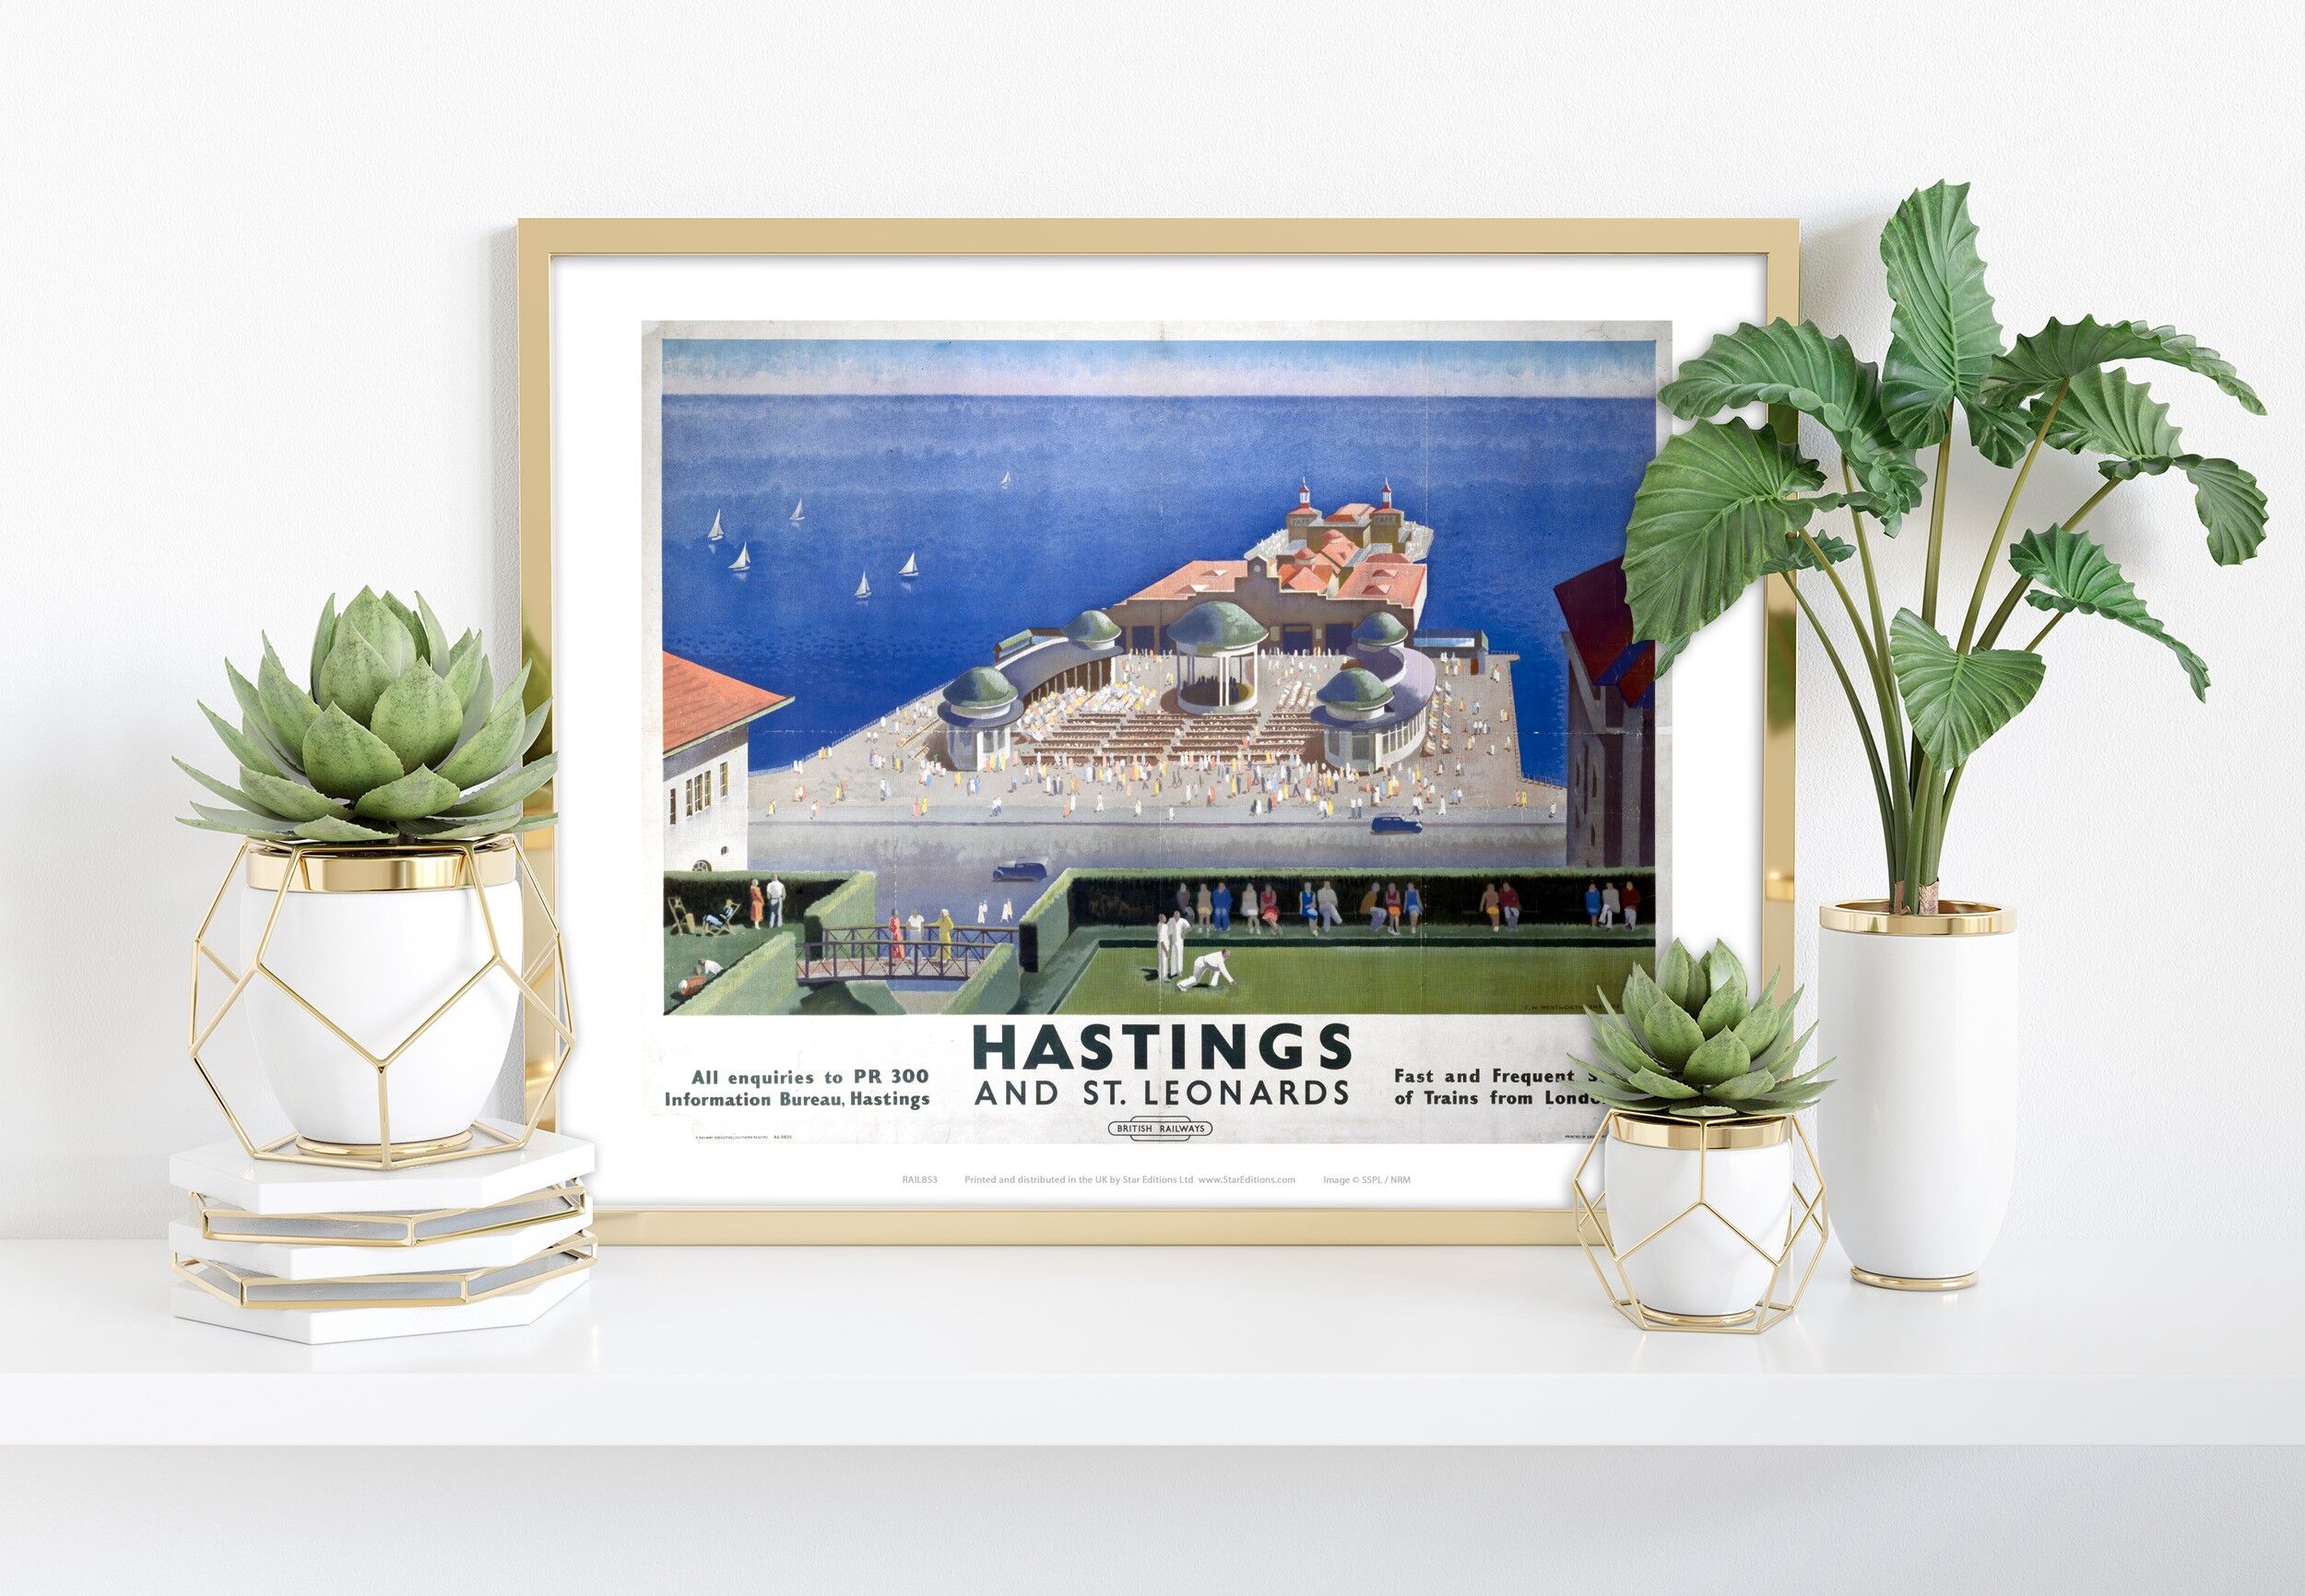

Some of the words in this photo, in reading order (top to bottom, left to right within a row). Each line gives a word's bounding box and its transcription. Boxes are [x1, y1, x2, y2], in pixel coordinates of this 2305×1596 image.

[973, 1023, 1352, 1070] HASTINGS
[692, 1070, 718, 1084] All
[727, 1070, 814, 1089] enquiries
[824, 1071, 843, 1084] to
[854, 1069, 882, 1084] PR
[892, 1069, 929, 1084] 300
[1395, 1068, 1434, 1083] Fast
[1445, 1068, 1480, 1083] and
[1493, 1068, 1575, 1087] Frequent
[665, 1092, 771, 1106] Information
[780, 1092, 845, 1108] Bureau,
[850, 1091, 930, 1111] Hastings
[975, 1080, 1058, 1105] AND
[1083, 1080, 1127, 1105] ST.
[1144, 1080, 1349, 1105] LEONARDS
[1394, 1090, 1414, 1105] of
[1424, 1090, 1479, 1105] Trains
[1489, 1090, 1533, 1105] from
[1545, 1090, 1605, 1105] Londo
[1117, 1124, 1152, 1133] BRITISH
[1159, 1124, 1205, 1133] RAILWAYS
[902, 1175, 938, 1184] RAIL853
[964, 1175, 997, 1184] Printed
[999, 1175, 1016, 1184] and
[1017, 1175, 1066, 1184] distributed
[1068, 1175, 1077, 1184] in
[1079, 1175, 1093, 1184] the
[1094, 1175, 1108, 1184] UK
[1109, 1175, 1121, 1186] by
[1122, 1175, 1141, 1184] Star
[1141, 1175, 1177, 1184] Editions
[1179, 1175, 1194, 1184] Ltd
[1198, 1175, 1296, 1184] www.StarEditions.com
[1323, 1176, 1351, 1187] Image
[1362, 1176, 1383, 1184] SSPL
[1390, 1176, 1411, 1184] NRM
